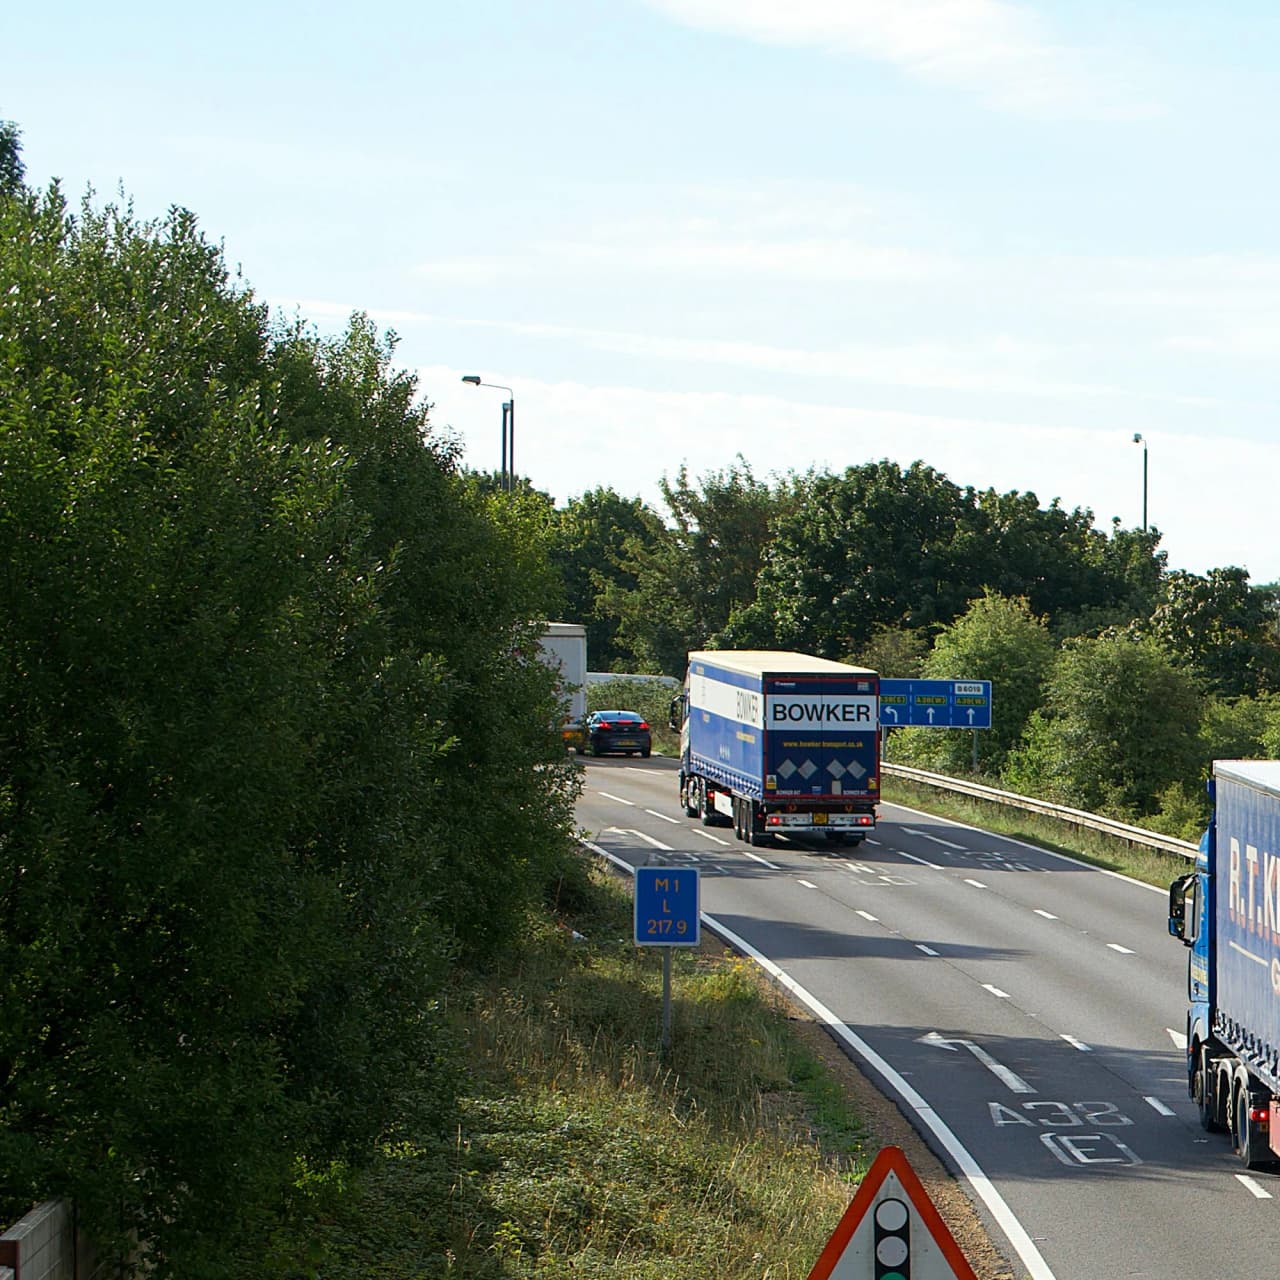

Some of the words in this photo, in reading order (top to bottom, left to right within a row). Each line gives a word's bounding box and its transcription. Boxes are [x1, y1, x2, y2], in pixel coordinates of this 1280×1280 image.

[773, 703, 870, 722] BOWKER
[663, 899, 671, 913] L
[987, 1101, 1135, 1128] A38
